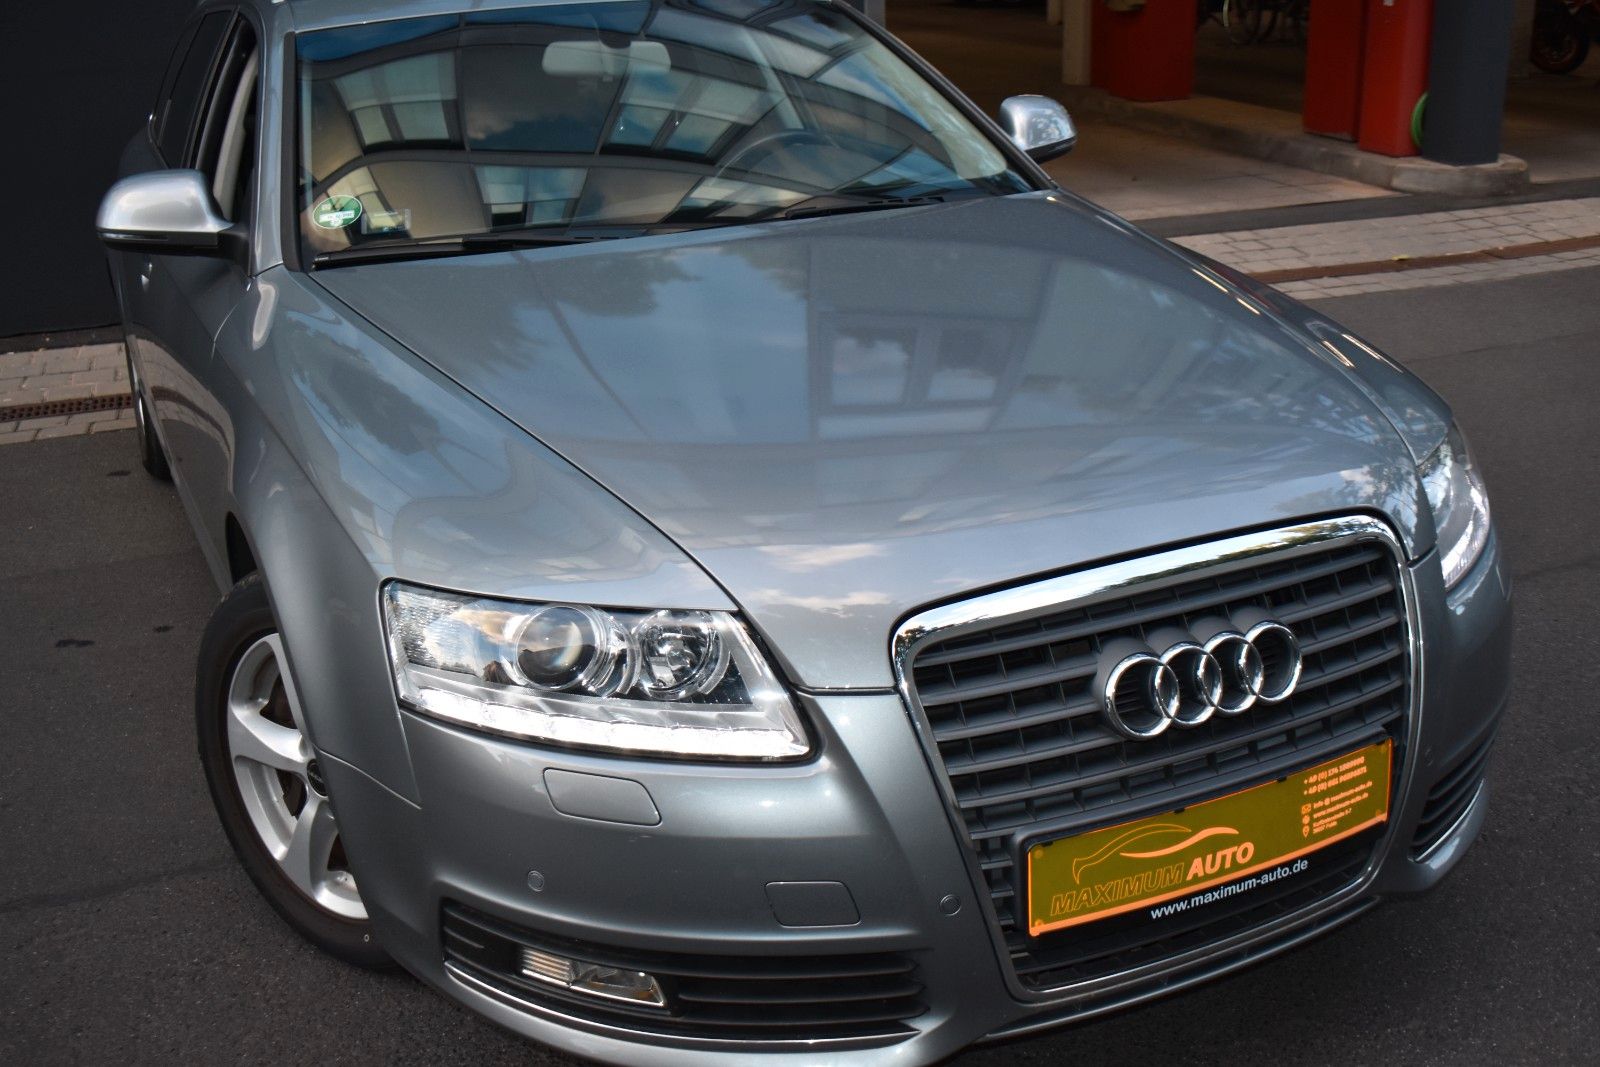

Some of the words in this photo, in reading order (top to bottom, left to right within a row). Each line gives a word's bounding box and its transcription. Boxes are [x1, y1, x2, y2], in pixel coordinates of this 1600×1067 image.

[1050, 862, 1185, 917] MAXIMUM
[1186, 841, 1255, 881] AUTO
[1150, 859, 1309, 920] www.maximum-auto.de
